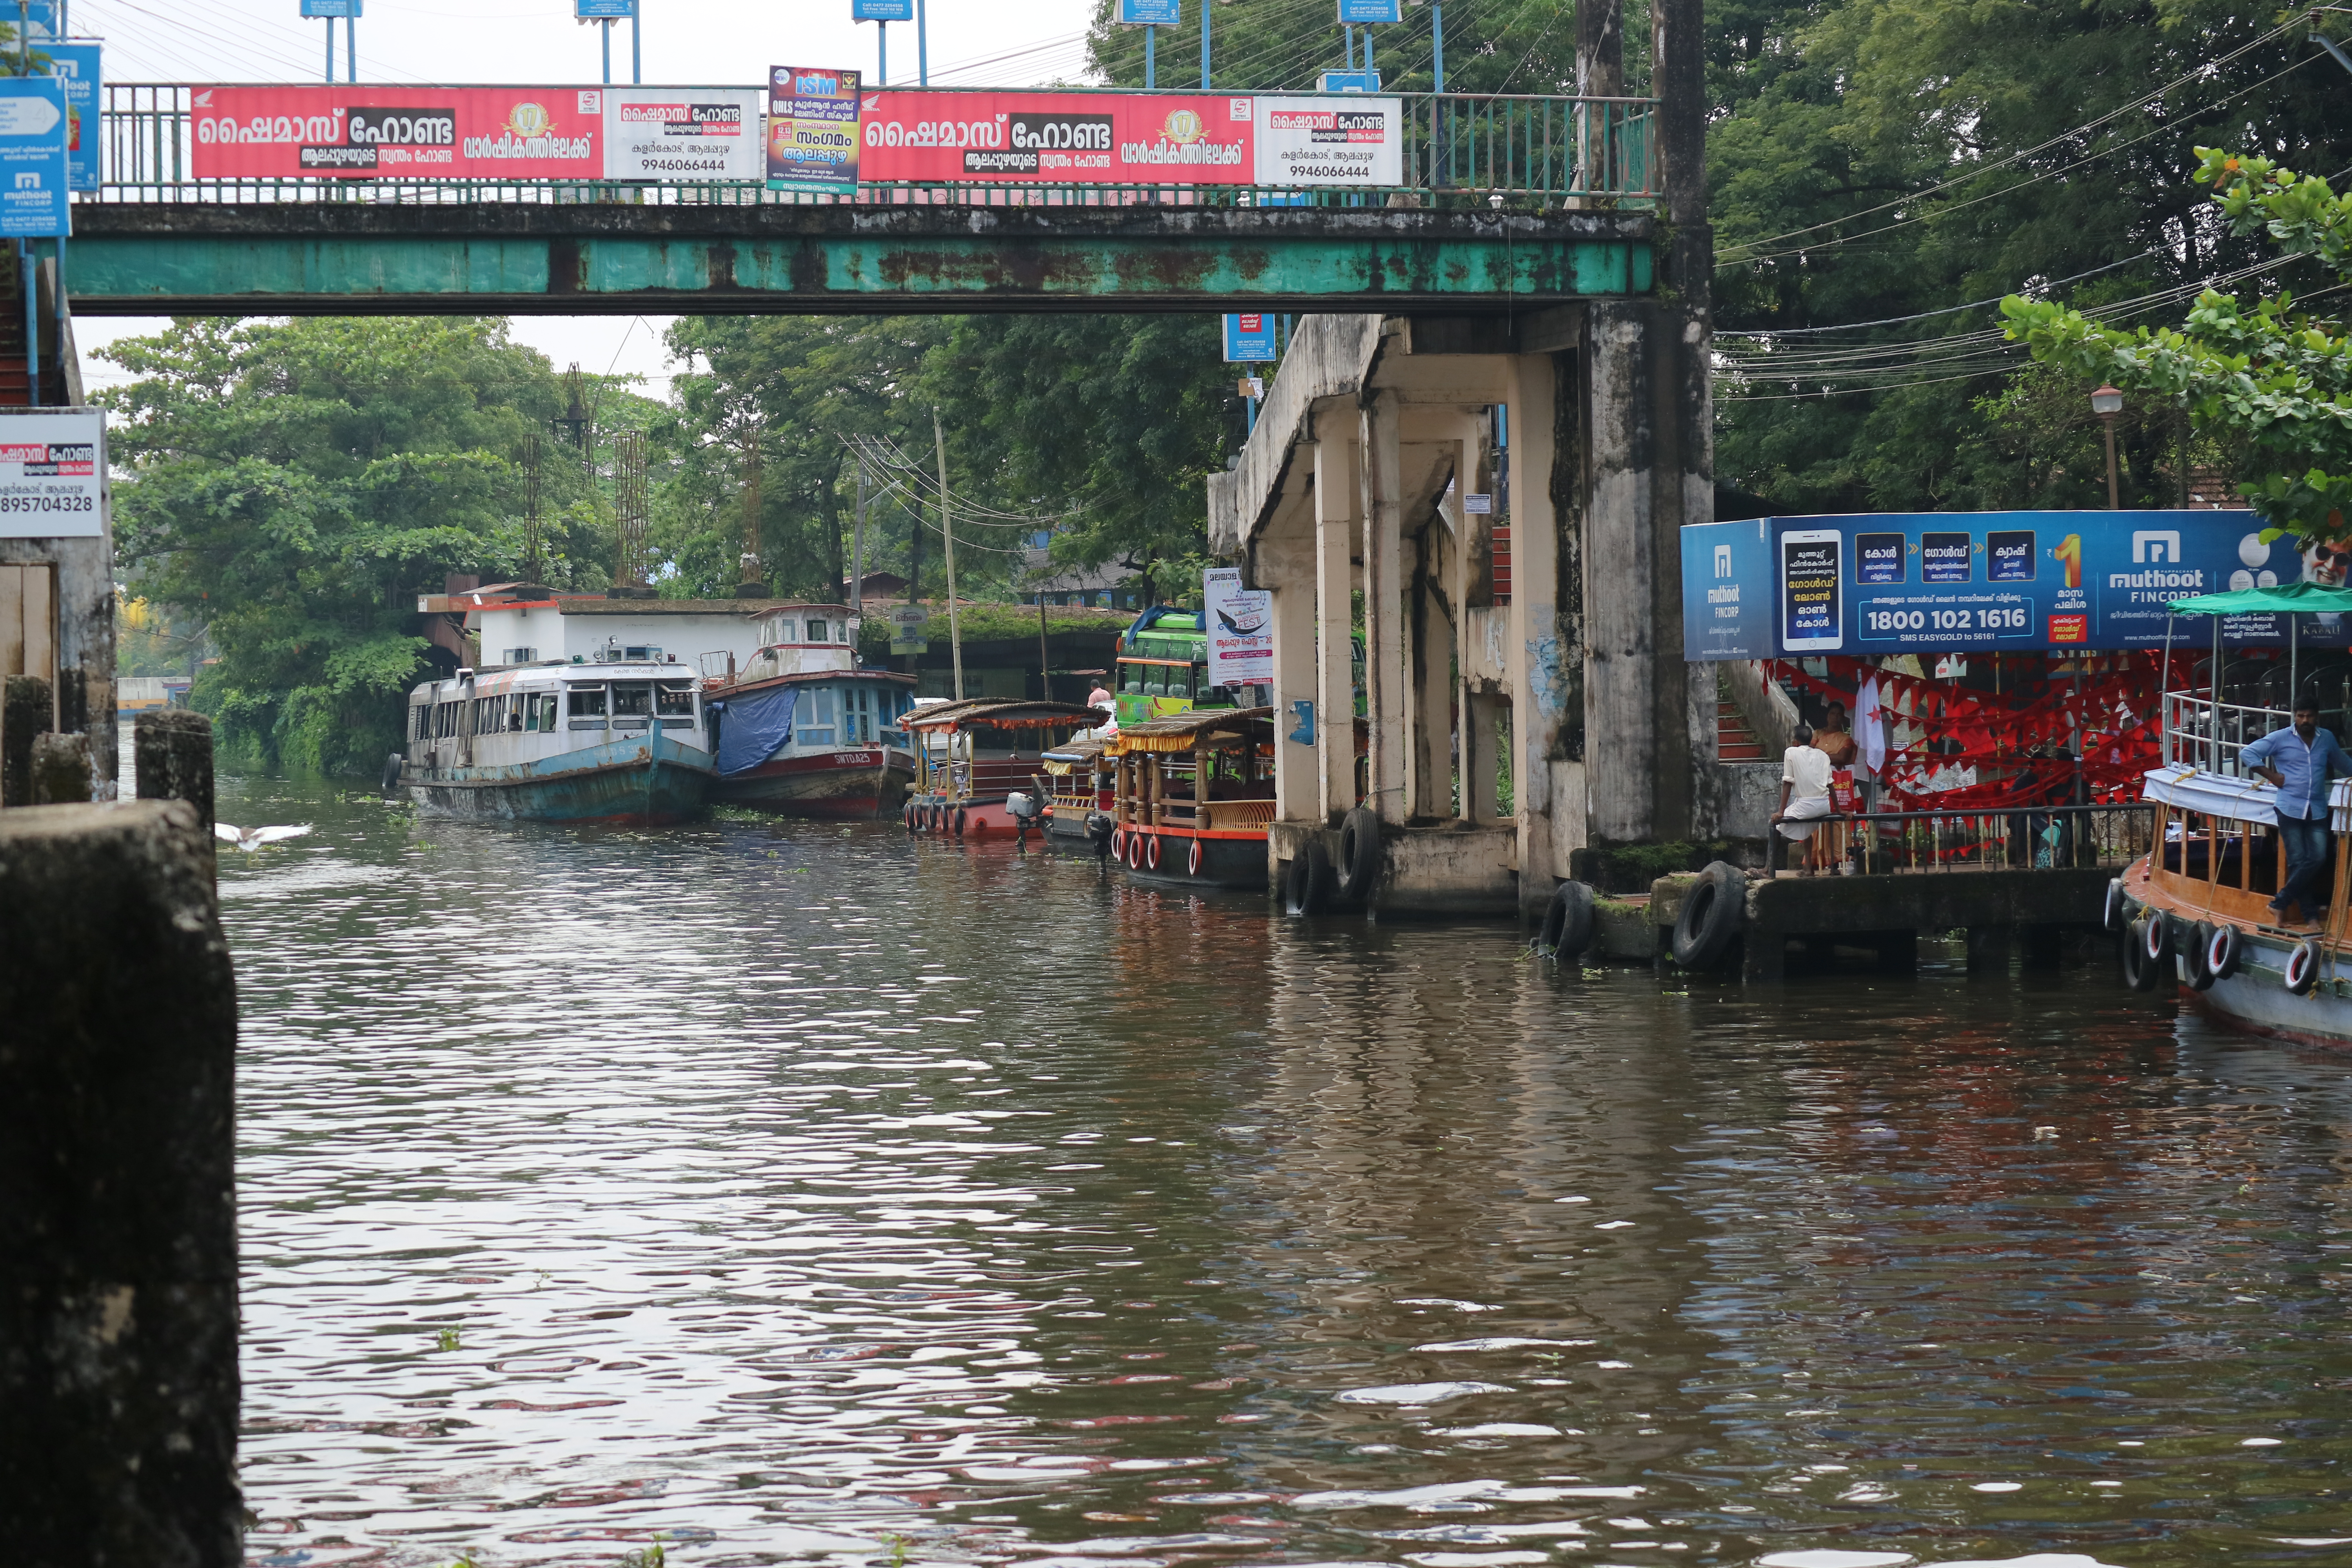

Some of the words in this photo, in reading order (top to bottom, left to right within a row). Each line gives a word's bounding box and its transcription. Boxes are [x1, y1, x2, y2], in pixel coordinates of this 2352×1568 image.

[795, 76, 837, 96] ISM
[622, 103, 690, 121] ഷൈമാസ്
[692, 107, 740, 122] ഹോണ്ട
[772, 100, 793, 114] QHLS
[519, 108, 537, 127] 17
[794, 109, 826, 118] ലേണിംഗ്
[198, 108, 345, 143] ഷൈമാസ്
[349, 116, 453, 143] ഹോണ്ട
[796, 121, 840, 130] സംസ്ഥാന
[1175, 114, 1192, 133] 17
[1272, 112, 1336, 129] ഷൈമാസ്
[1338, 115, 1383, 130] ഹോണ്ട
[664, 124, 702, 134] ആലപ്പുഴയുടെ
[703, 125, 720, 134] സ്വന്തം
[866, 114, 1007, 147] ഷൈമാസ്
[1011, 122, 1111, 149] ഹോണ്ട
[796, 131, 852, 146] സംഗമം
[1312, 132, 1347, 142] ആലപ്പുഴയുടെ
[1348, 132, 1364, 141] സ്വന്തം
[463, 131, 593, 159] വാർഷികത്തിലേക്ക്
[687, 144, 730, 156] ആലപ്പുഴ
[1121, 137, 1244, 165] വാർഷികത്തിലേക്ക്
[301, 148, 376, 166] ആലപ്പുഴയുടെ
[379, 149, 412, 164] സ്വന്തം
[414, 149, 452, 163] ഹോണ്ട
[782, 147, 848, 166] ആലപ്പുഴ
[965, 152, 1037, 171] ആലപ്പുഴയുടെ
[1040, 154, 1072, 169] സ്വന്തം
[1074, 154, 1111, 168] ഹോണ്ട
[1333, 152, 1374, 163] ആലപ്പുഴ
[641, 158, 725, 171] 9946066444
[1290, 165, 1370, 177] 9946066444
[783, 183, 840, 192] സ്വാഗതസംഘം
[4, 190, 53, 200] muthoot
[49, 447, 93, 462] ഹോണ്ട
[45, 485, 83, 496] ആലപ്പുഴ
[1865, 546, 1897, 559] കോൾ
[1924, 545, 1968, 558] ഗോൾഡ്
[1995, 543, 2027, 559] ക്യാഷ്
[1789, 559, 1835, 567] ഫിൻകോർപ്പ്
[2054, 533, 2082, 588] 1
[1209, 572, 1237, 581] മലയാള
[1788, 576, 1837, 588] ഗോൾഡ്
[2109, 569, 2203, 588] muthoot
[1708, 584, 1740, 603] muthoot
[1794, 590, 1831, 602] ലോൺ
[1872, 597, 1905, 605] ഞങ്ങളുടെ
[1907, 594, 1935, 603] ഗോൾഡ്
[1936, 594, 1956, 603] ലൈൻ
[1958, 593, 1995, 602] നമ്പറിലേക്ക്
[2054, 597, 2087, 608] പലിശ
[1715, 606, 1739, 618] FINCORP
[1798, 603, 1827, 615] ഓൺ
[895, 612, 922, 622] Ethens
[1238, 613, 1259, 621] ALAPPUZHA
[1238, 616, 1260, 630] FEST
[1796, 617, 1829, 628] കോൾ
[1867, 610, 1925, 630] 1800
[1931, 610, 1971, 629] 102
[1977, 608, 2026, 628] 1616
[2223, 630, 2243, 639] വെള്ളി
[2302, 625, 2340, 635] KABALI
[1216, 639, 1240, 648] ആലപ്പുഴ
[834, 753, 871, 764] SWTD.A25
